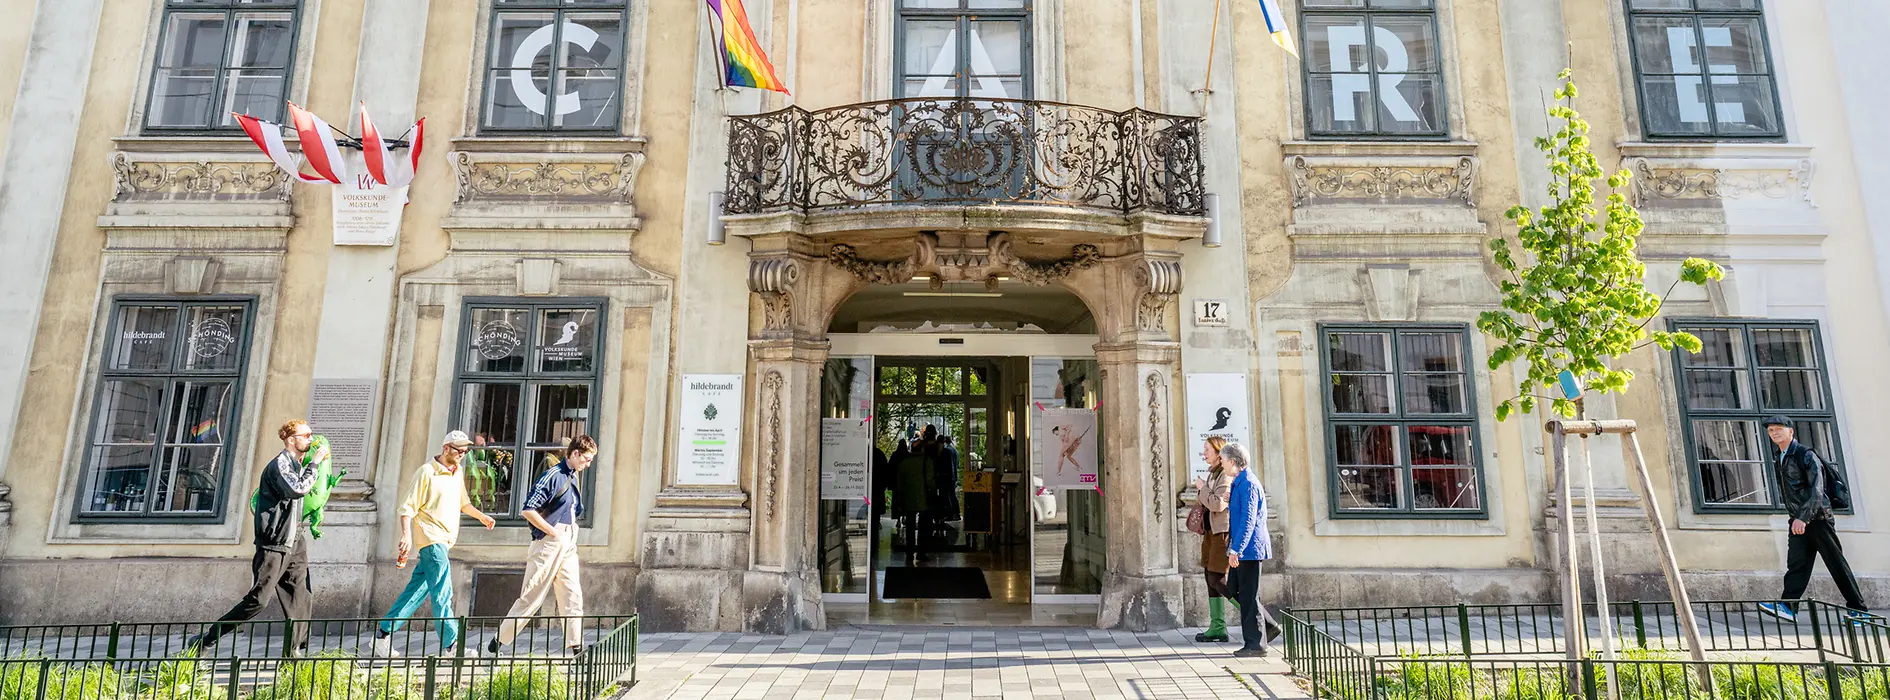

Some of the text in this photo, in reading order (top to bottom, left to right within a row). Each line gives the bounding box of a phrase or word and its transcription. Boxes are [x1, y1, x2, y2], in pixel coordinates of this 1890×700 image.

[511, 22, 1745, 123] C A R E
[1204, 302, 1220, 318] 17
